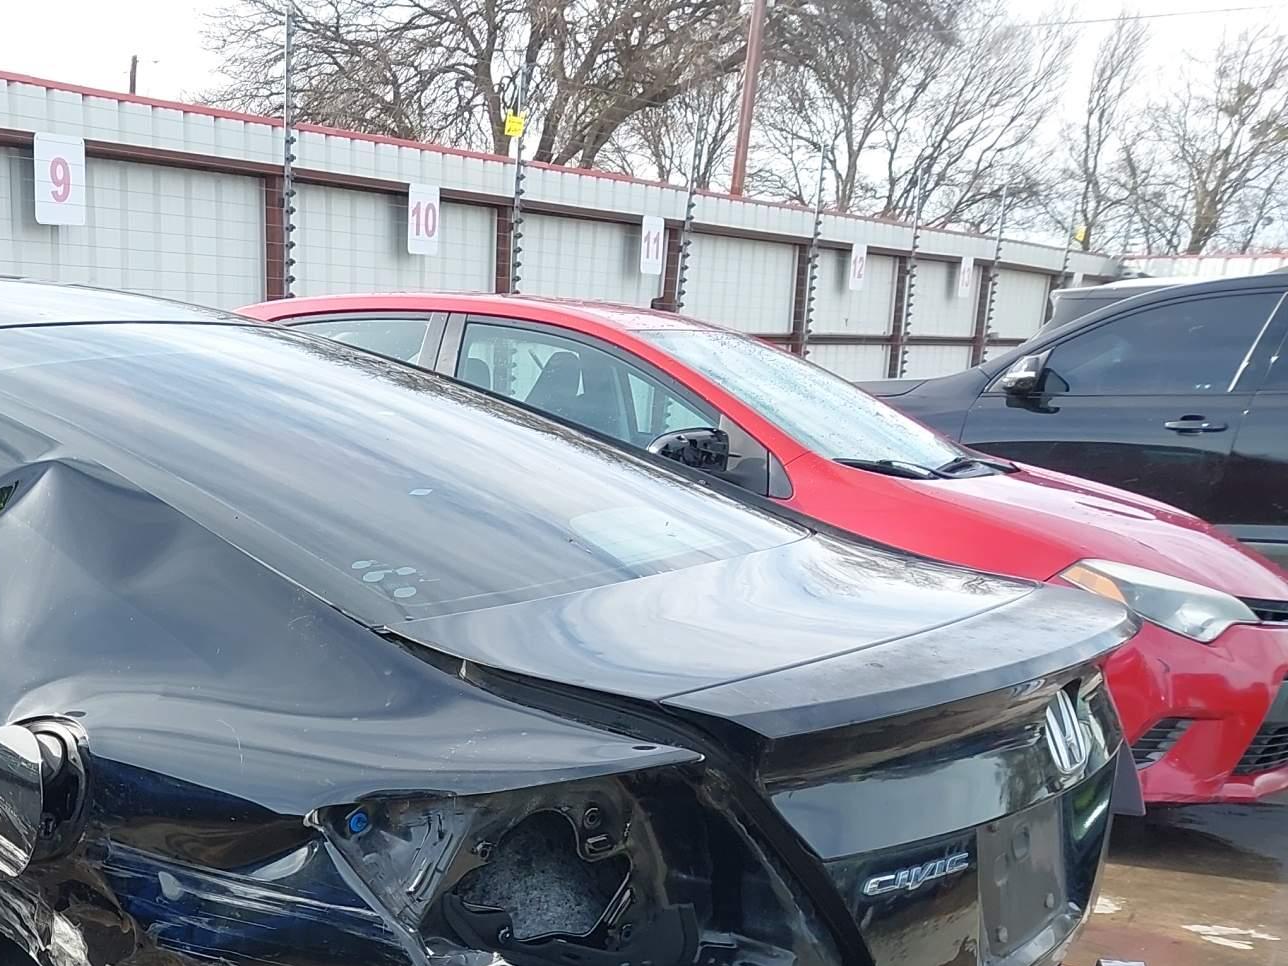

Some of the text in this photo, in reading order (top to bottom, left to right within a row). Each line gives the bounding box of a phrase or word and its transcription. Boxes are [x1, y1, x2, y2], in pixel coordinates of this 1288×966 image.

[50, 157, 71, 203] 9
[412, 201, 437, 238] 10
[644, 231, 660, 260] 11
[852, 256, 865, 279] 12
[863, 852, 969, 897] CIVIC
